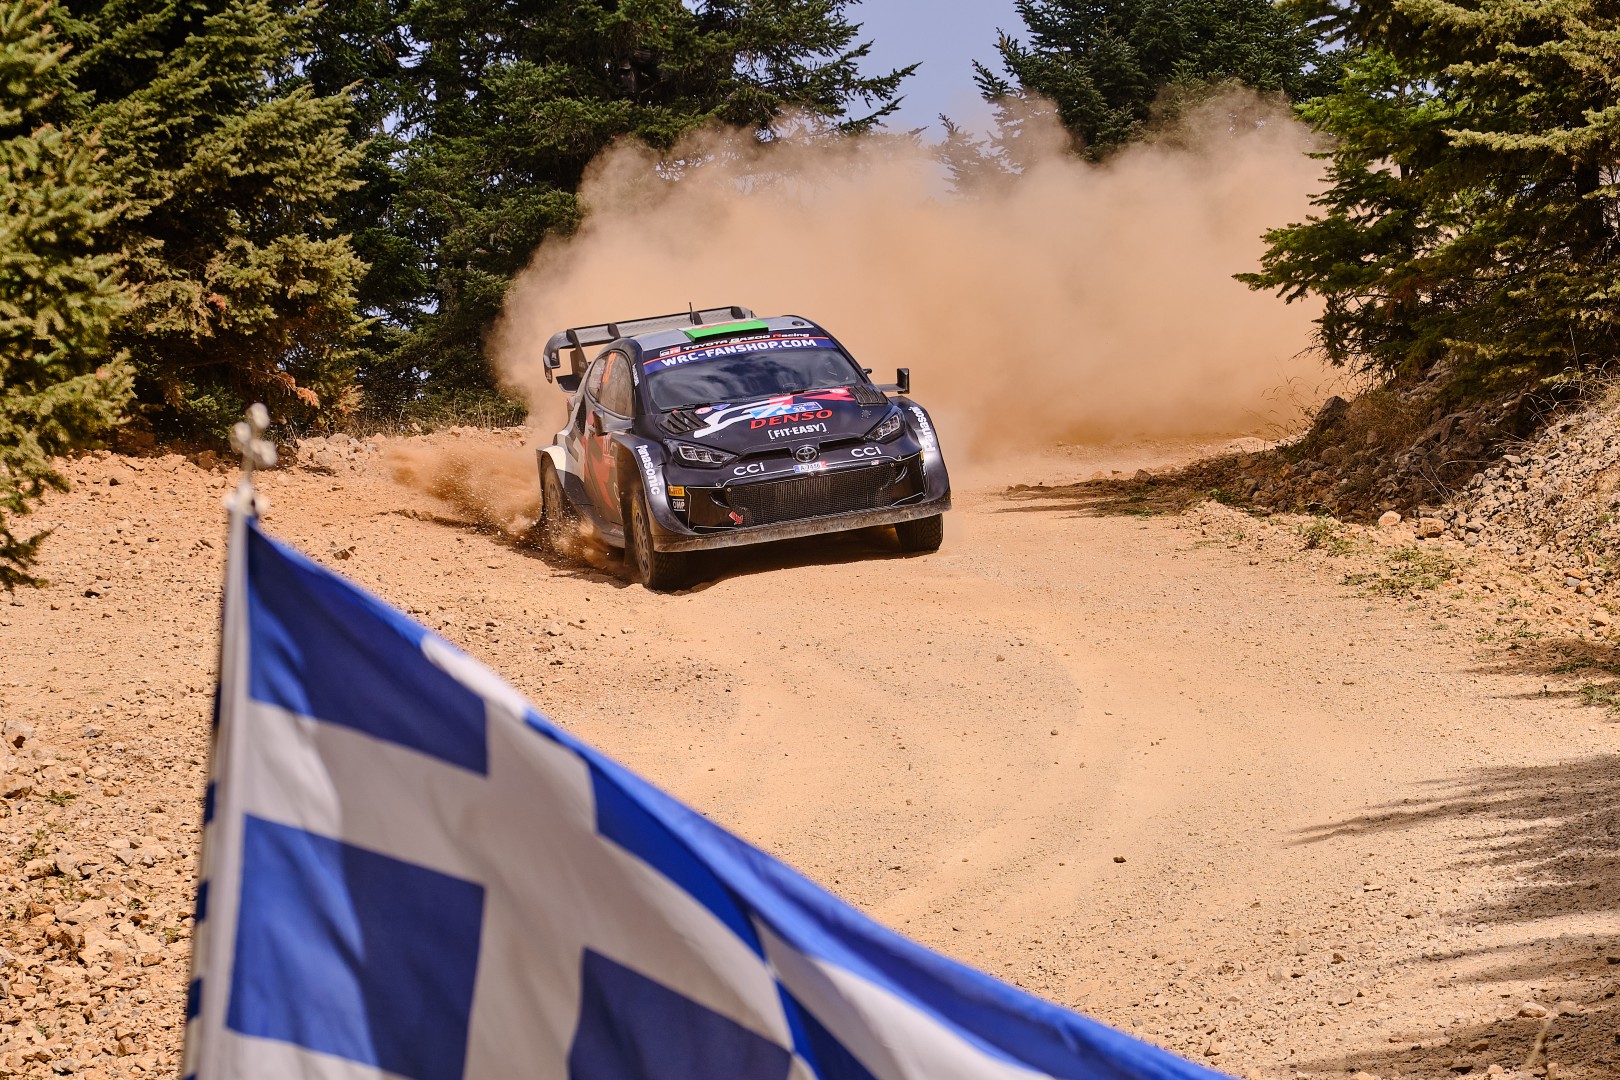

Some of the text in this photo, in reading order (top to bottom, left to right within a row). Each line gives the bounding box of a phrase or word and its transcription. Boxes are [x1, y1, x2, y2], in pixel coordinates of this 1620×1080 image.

[661, 339, 817, 367] WRC-FANSHOP.COM
[683, 340, 728, 351] TOYOTA
[750, 410, 833, 430] DENSO
[635, 444, 662, 496] Panasonic
